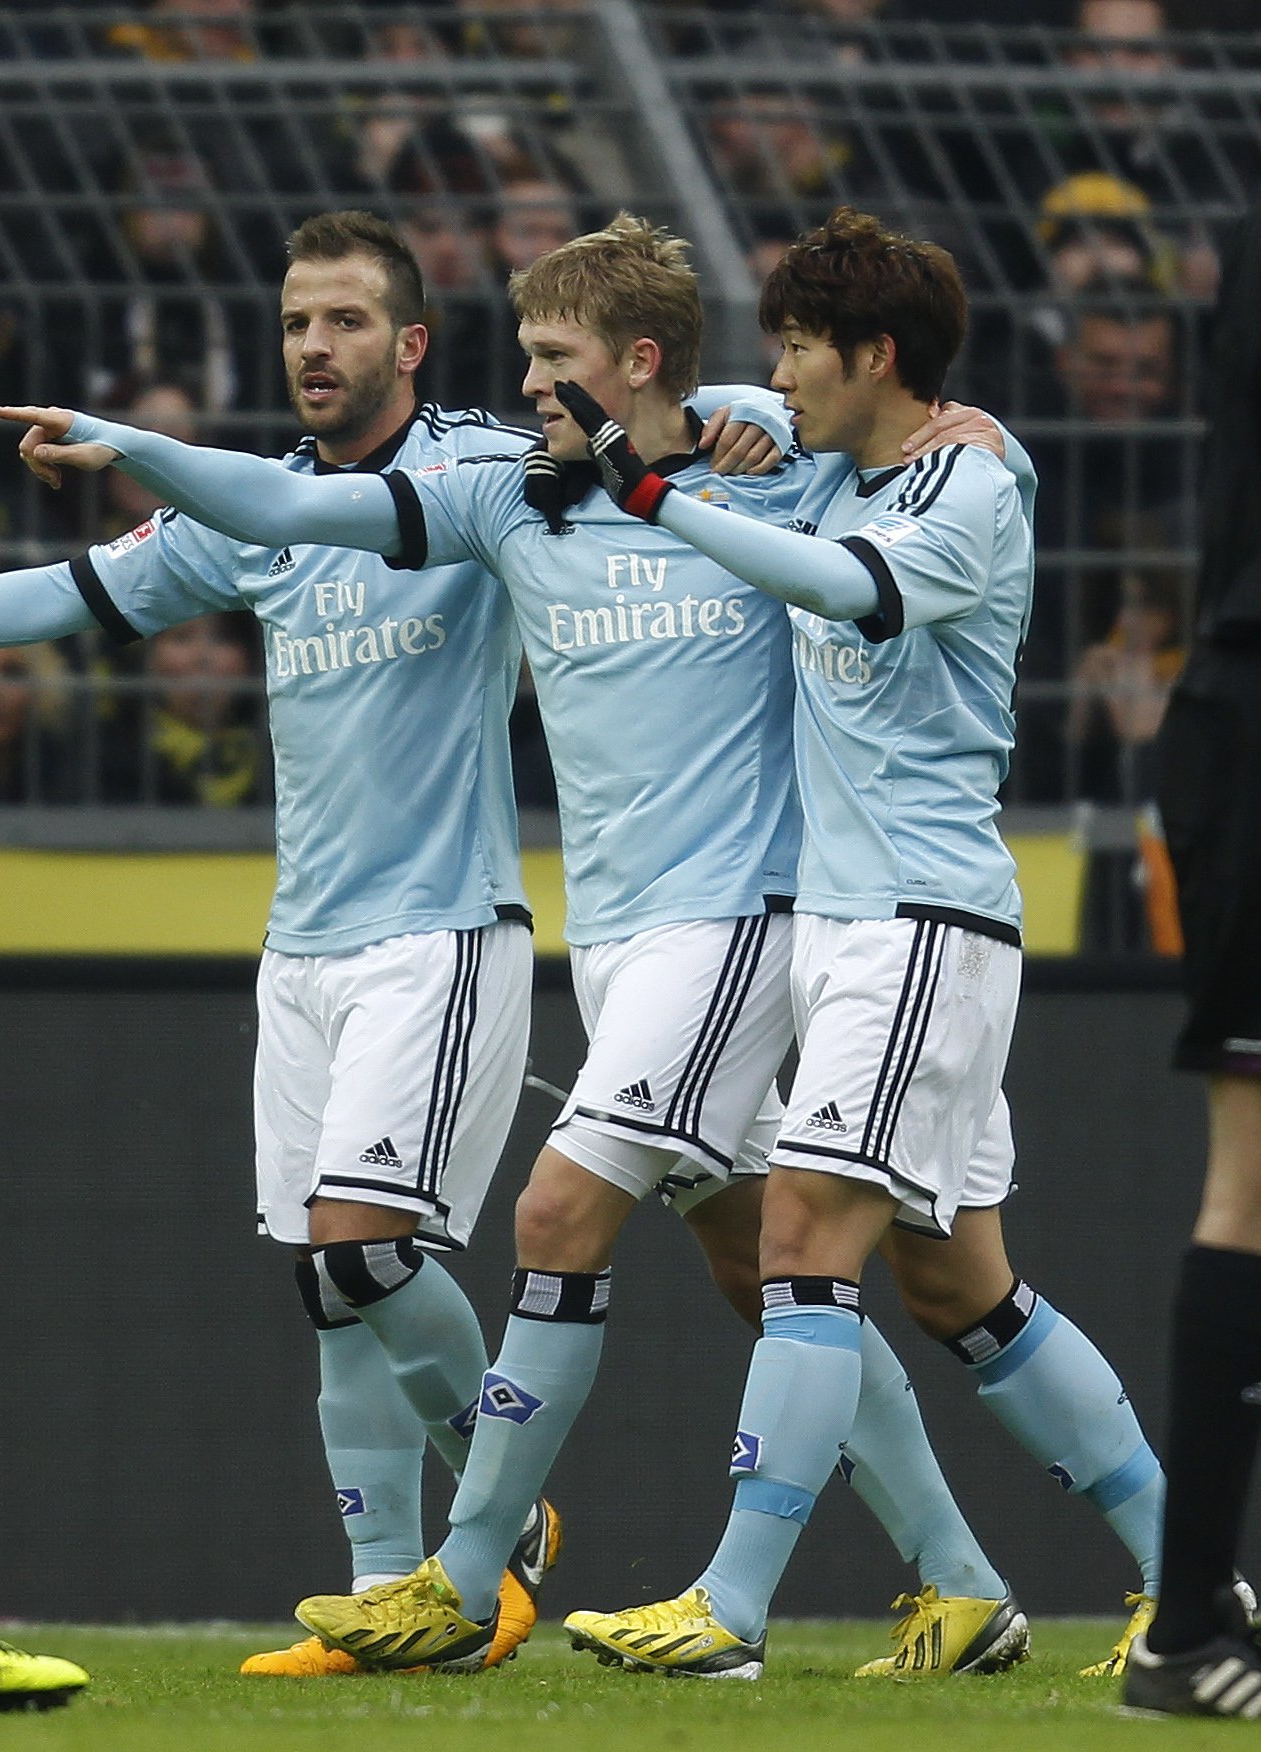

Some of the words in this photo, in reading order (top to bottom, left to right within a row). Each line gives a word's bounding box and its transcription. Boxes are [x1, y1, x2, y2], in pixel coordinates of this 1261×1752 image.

[606, 553, 668, 592] Fly
[313, 581, 366, 617] Fly
[546, 594, 745, 651] Emirates
[273, 614, 447, 677] Emirates
[613, 1092, 656, 1112] adidas
[805, 1117, 847, 1133] adidas
[358, 1152, 403, 1169] adidas
